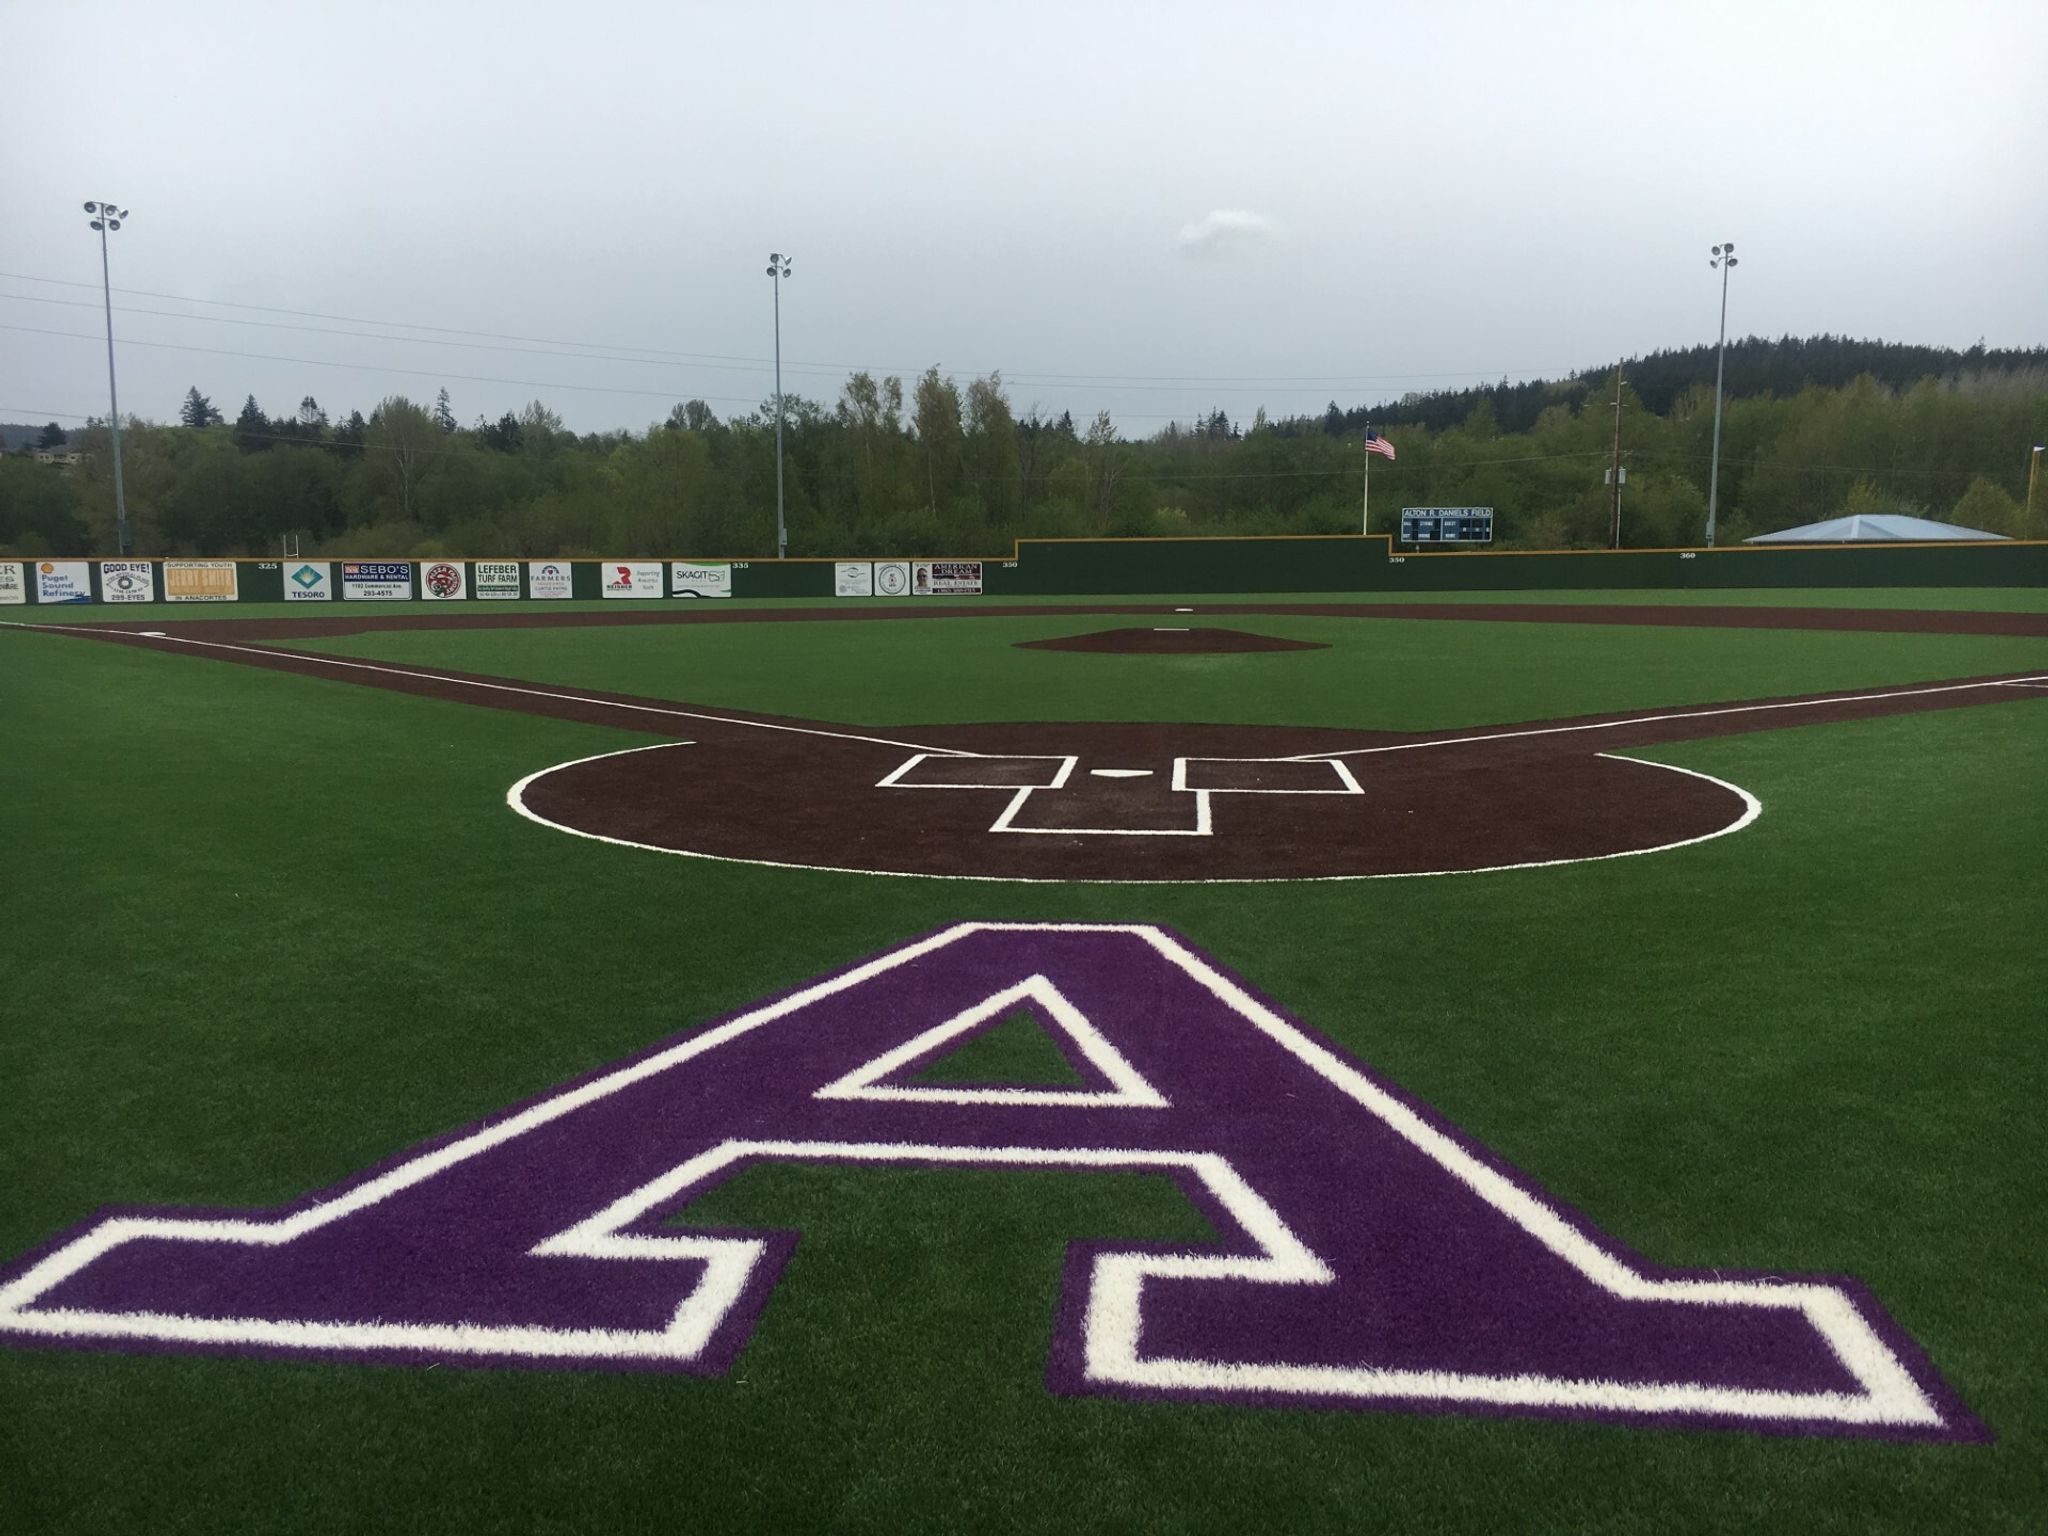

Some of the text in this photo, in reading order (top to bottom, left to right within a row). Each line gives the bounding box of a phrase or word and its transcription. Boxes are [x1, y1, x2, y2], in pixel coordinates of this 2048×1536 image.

[1404, 509, 1427, 517] ALTON
[1440, 509, 1468, 517] DANIELS
[1471, 508, 1491, 516] FIELD
[103, 564, 150, 574] GOOD EYE!
[360, 565, 409, 574] SEBO'S
[478, 565, 517, 574] LEFEBER
[42, 574, 68, 582] Puget
[478, 574, 518, 583] TURF FARM
[676, 571, 706, 579] SKAGIT
